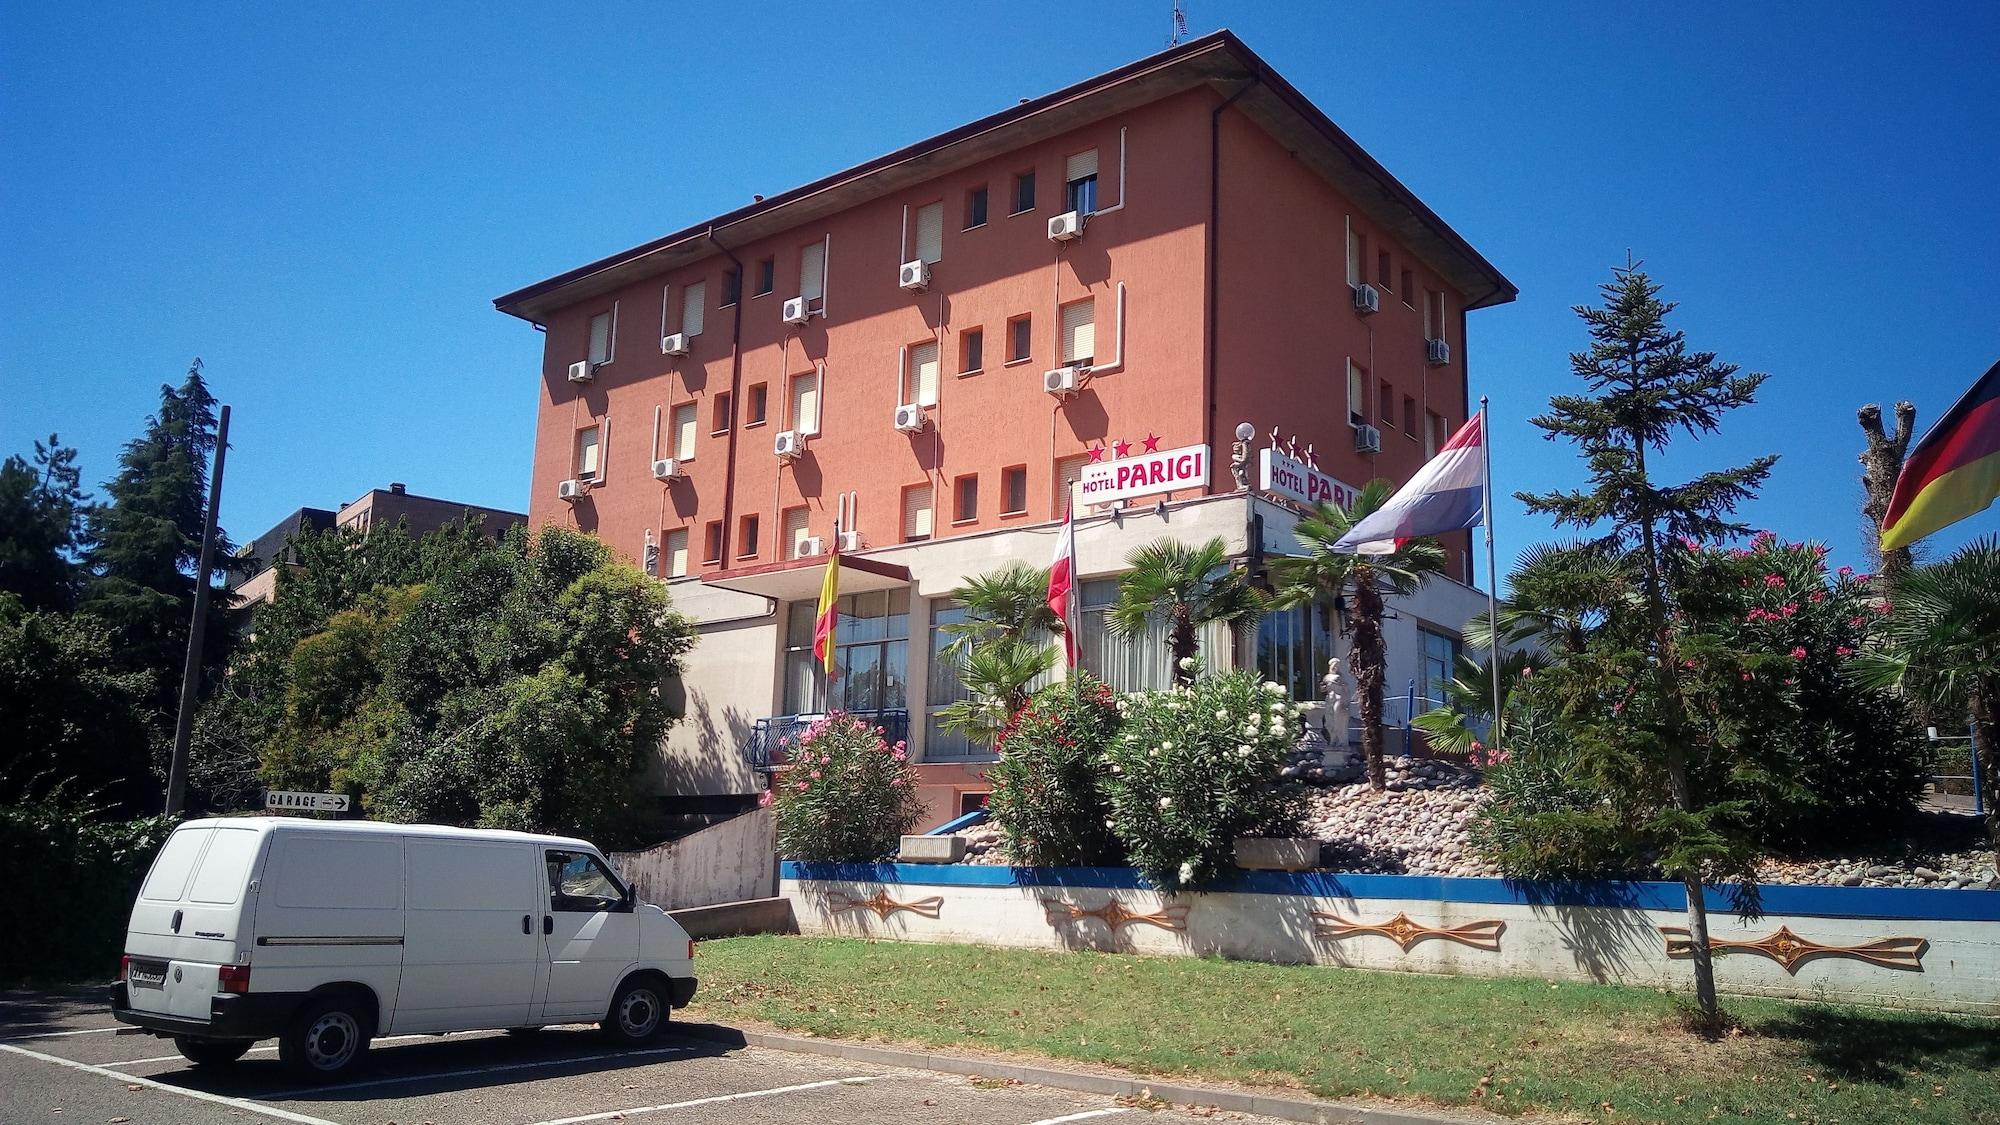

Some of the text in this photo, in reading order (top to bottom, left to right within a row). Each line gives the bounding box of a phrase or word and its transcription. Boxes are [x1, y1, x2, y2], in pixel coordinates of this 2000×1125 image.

[1083, 453, 1201, 494] HOTEL PARIGI
[1272, 465, 1353, 512] HOTEL PARI
[269, 794, 316, 807] GARAGE
